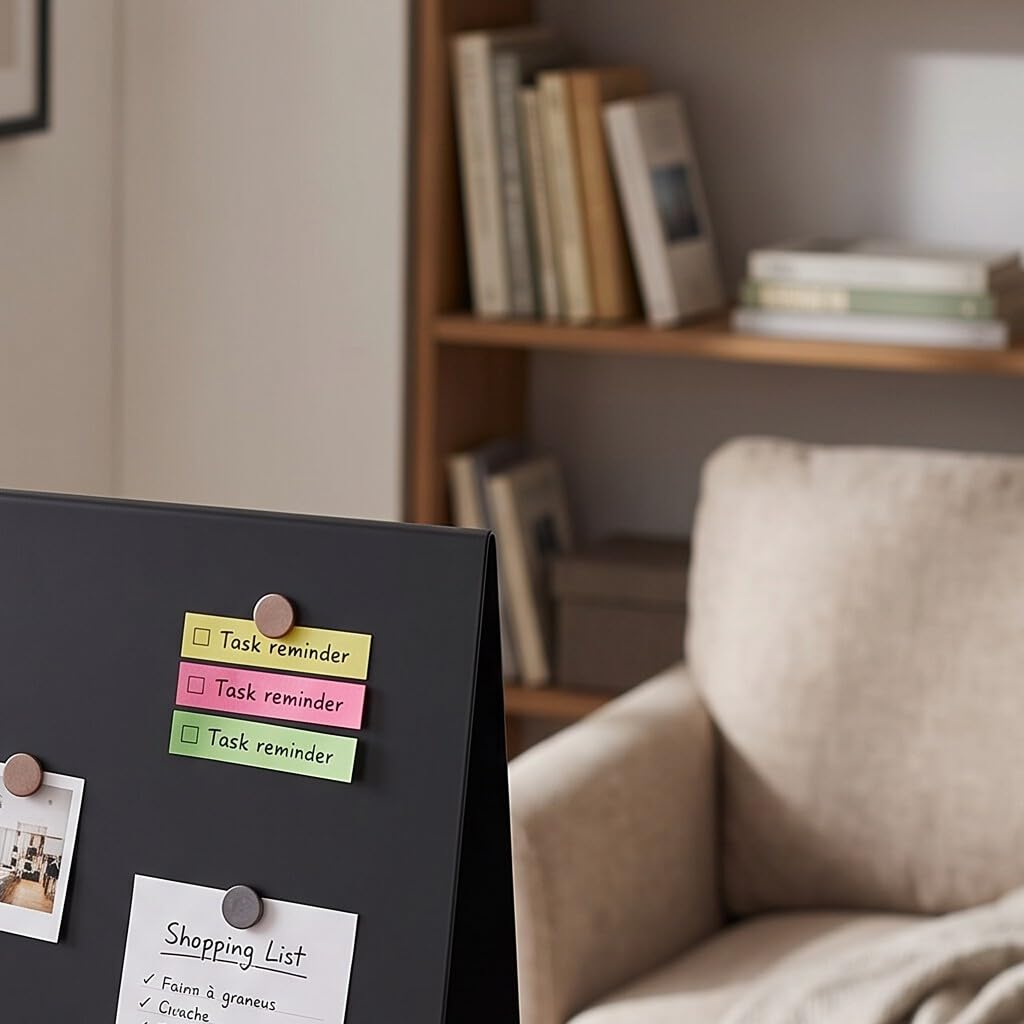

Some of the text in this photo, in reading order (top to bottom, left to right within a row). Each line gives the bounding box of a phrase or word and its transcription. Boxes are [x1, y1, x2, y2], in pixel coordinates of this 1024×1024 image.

[220, 630, 350, 663] Task reminder
[215, 678, 344, 712] Task reminder
[208, 728, 334, 764] Task reminder
[164, 921, 307, 970] Shopping List
[206, 985, 215, 999] à
